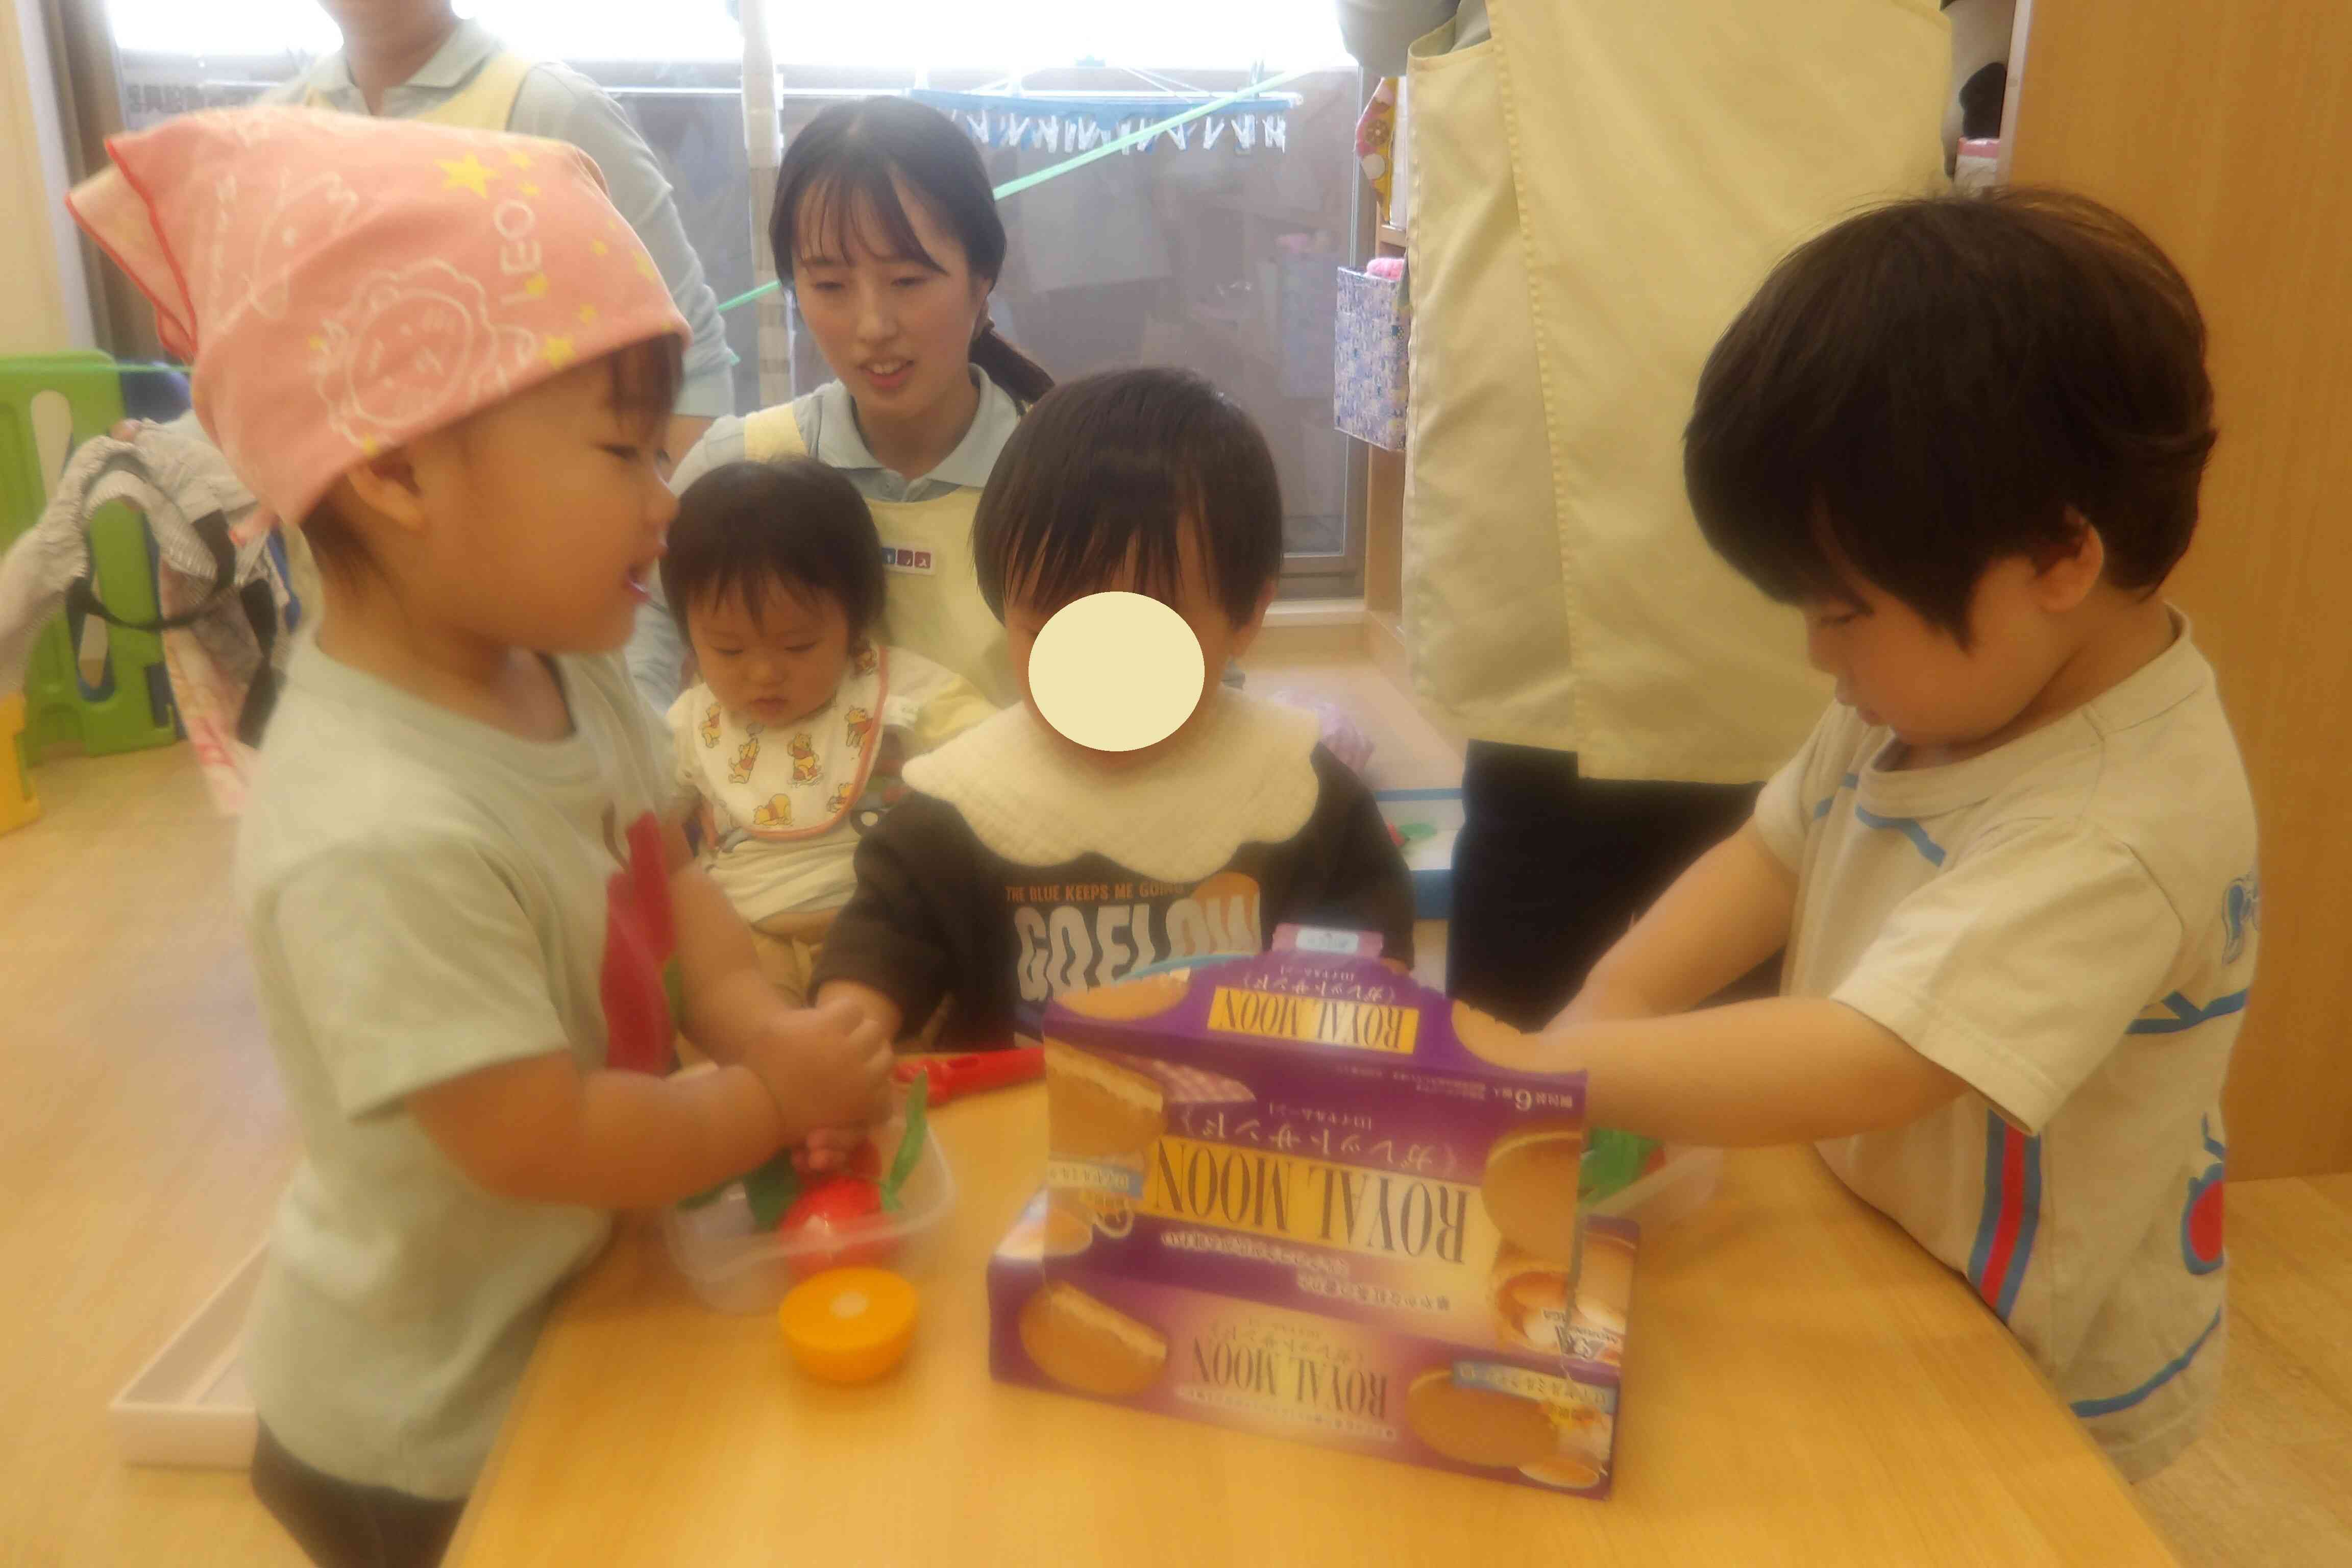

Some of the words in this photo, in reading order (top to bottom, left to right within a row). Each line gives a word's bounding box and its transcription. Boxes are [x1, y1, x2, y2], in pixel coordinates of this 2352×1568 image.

[1005, 886, 1025, 902] THE
[1029, 884, 1060, 902] BLUE
[1065, 883, 1109, 902] KEEPS
[1114, 882, 1133, 899] ME
[1217, 989, 1299, 1037] MOON
[1311, 1000, 1402, 1048] ROYAL
[1152, 1137, 1291, 1233] MOON
[1306, 1165, 1469, 1265] ROYAL
[1191, 1336, 1280, 1396] MOON
[1288, 1356, 1387, 1421] ROYAL
